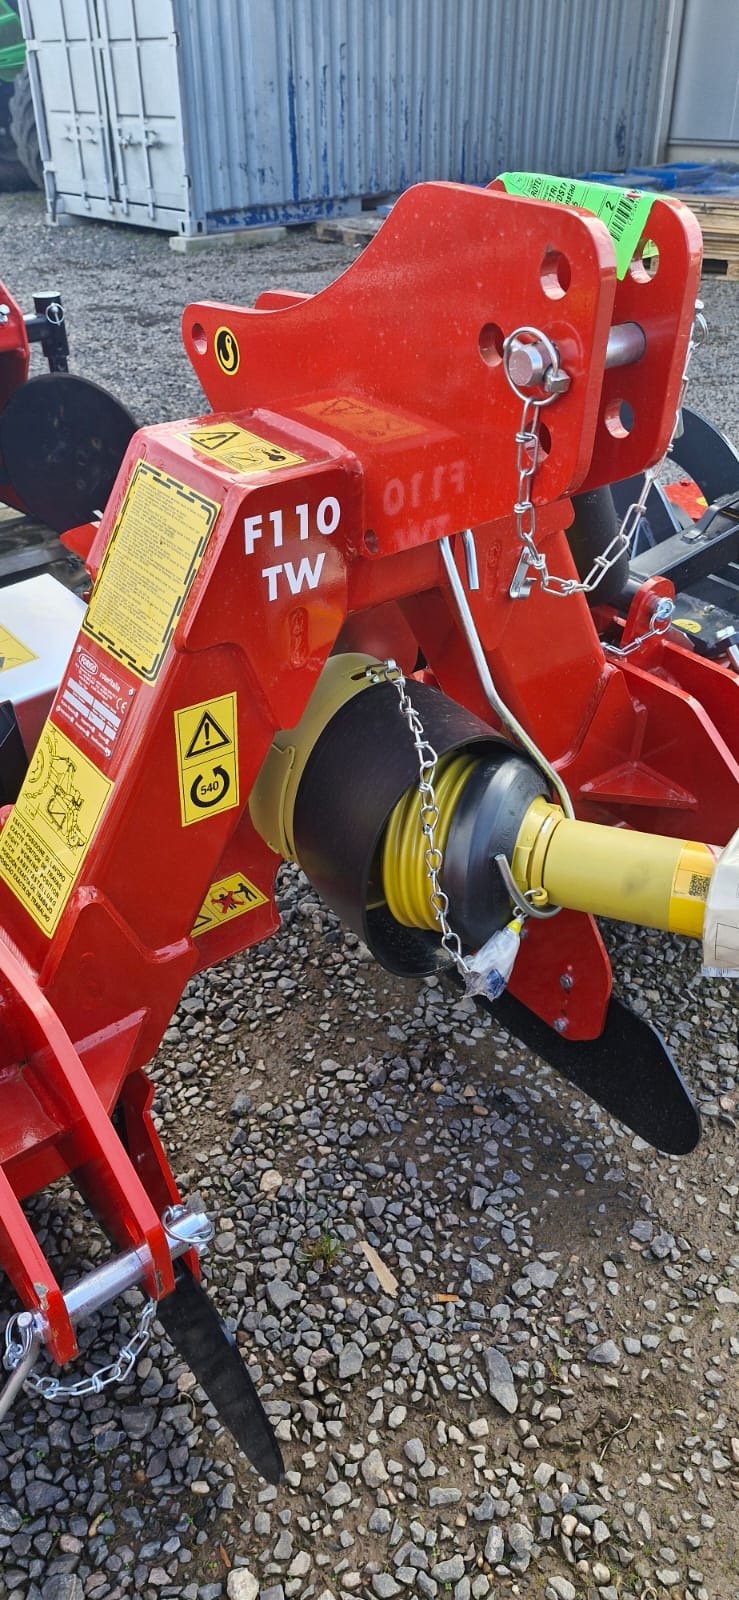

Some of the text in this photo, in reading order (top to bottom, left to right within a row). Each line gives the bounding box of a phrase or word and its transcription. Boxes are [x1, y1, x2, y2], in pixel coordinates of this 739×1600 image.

[605, 200, 614, 211] 2
[244, 496, 341, 555] F110
[262, 552, 326, 602] TW
[116, 697, 128, 714] CE
[200, 781, 219, 795] 540
[24, 842, 41, 863] POSITION
[26, 833, 45, 858] POSIZIONE
[50, 861, 65, 882] LAVORO
[40, 873, 58, 898] POSITION
